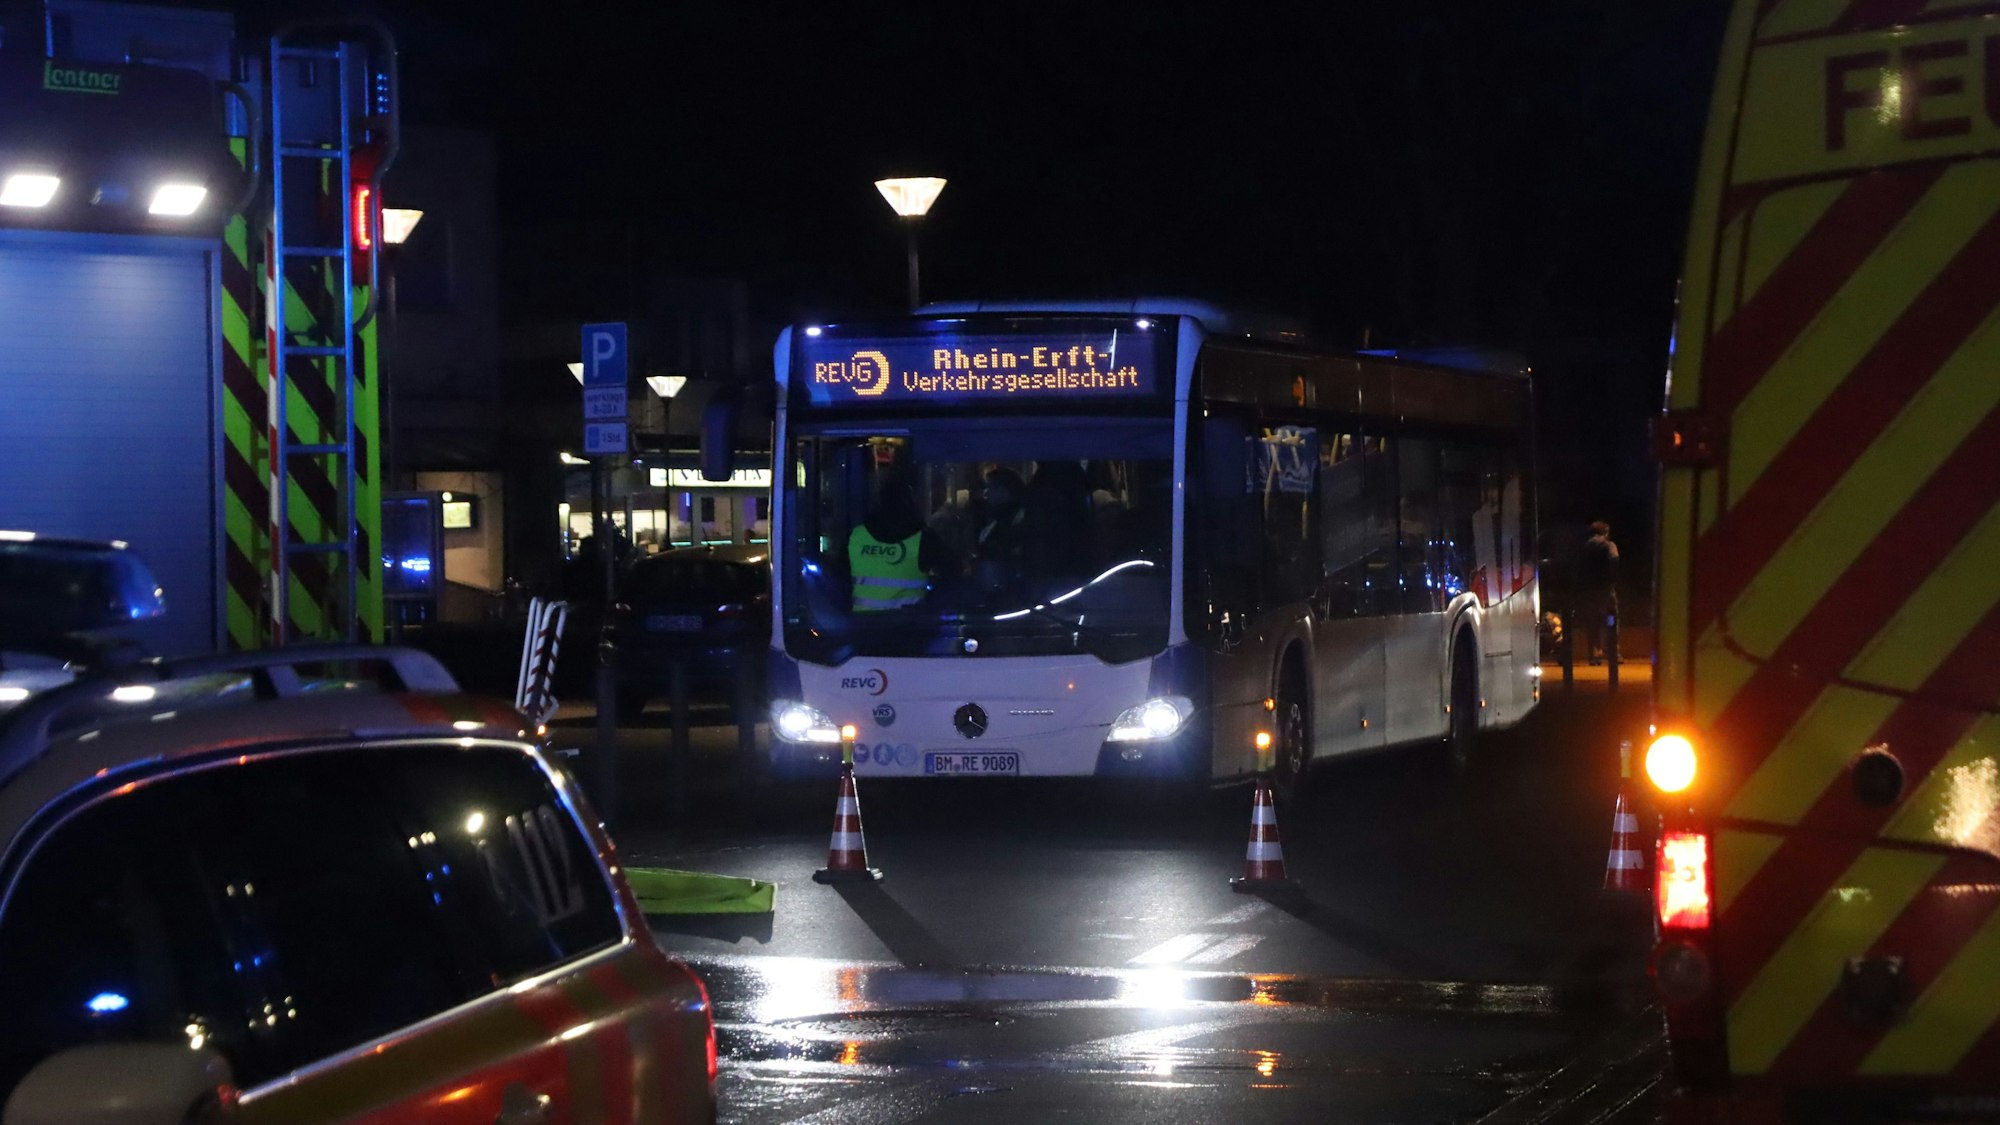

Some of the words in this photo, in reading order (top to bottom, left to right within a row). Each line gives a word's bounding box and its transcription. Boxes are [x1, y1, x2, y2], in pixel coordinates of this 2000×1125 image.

[1825, 35, 2000, 151] FE
[592, 332, 616, 377] P
[933, 345, 1108, 370] Rhein-Erft-
[815, 362, 872, 383] REVG
[903, 366, 1138, 392] Verkehrsgesellschaft
[861, 545, 897, 556] REVG
[841, 677, 877, 689] REVG
[872, 707, 891, 717] VRS
[935, 756, 953, 772] BM
[962, 756, 979, 772] RE
[982, 755, 1015, 772] 9089
